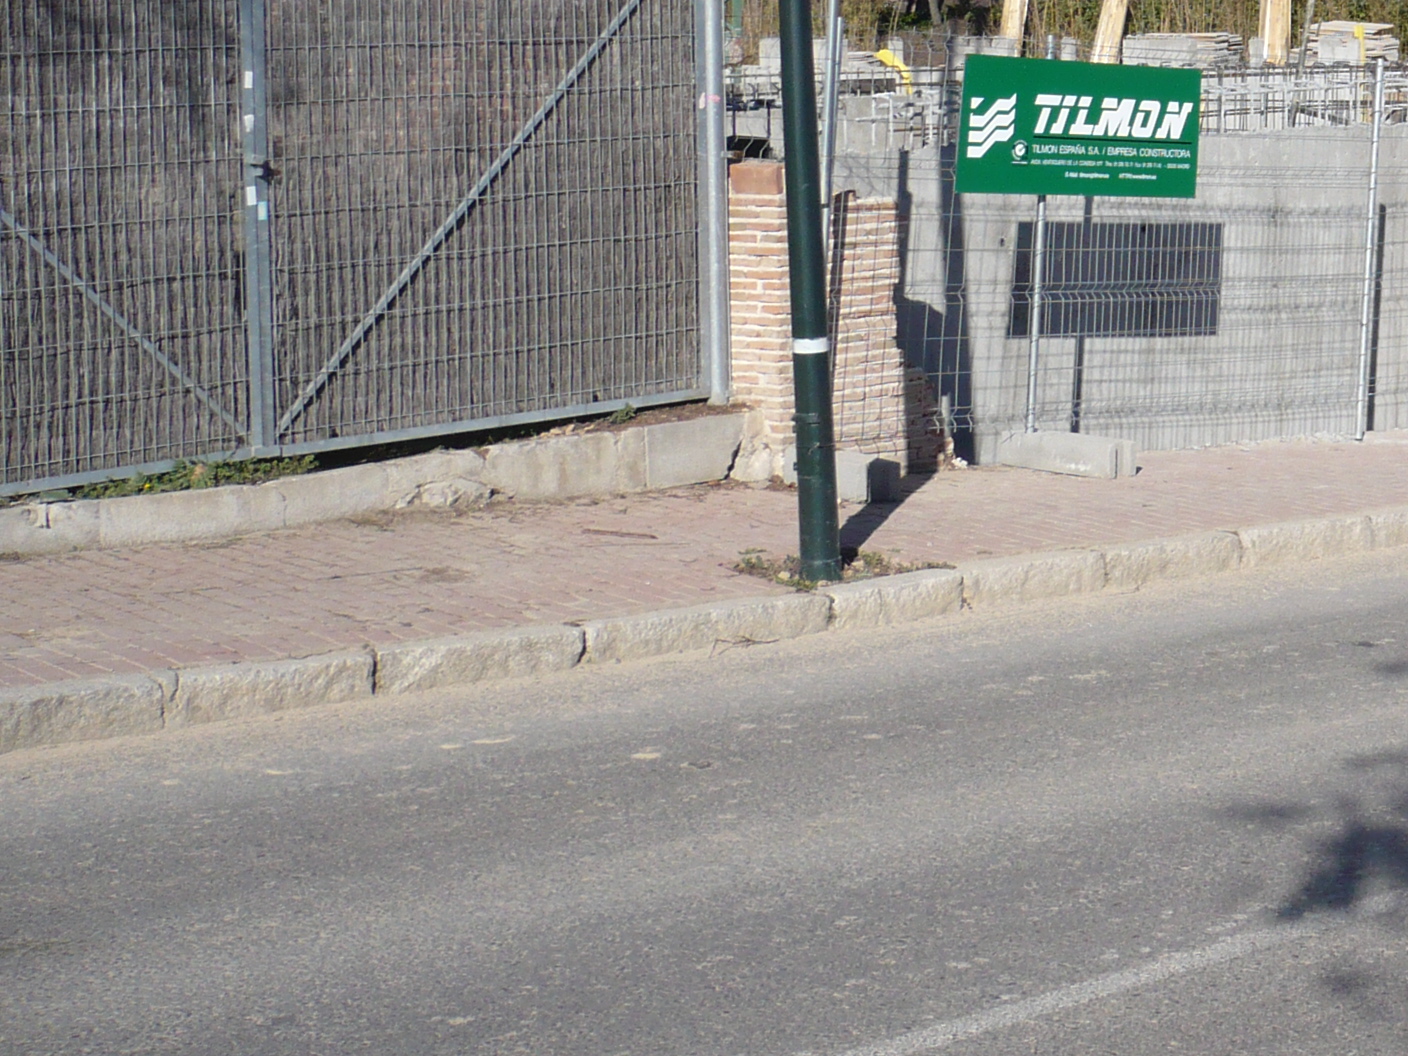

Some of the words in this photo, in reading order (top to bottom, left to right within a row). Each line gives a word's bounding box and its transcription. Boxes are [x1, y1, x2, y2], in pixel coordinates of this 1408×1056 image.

[1033, 93, 1194, 139] TILMON
[1032, 144, 1058, 154] TILMON
[1059, 144, 1086, 155] ESPAÑA
[1107, 146, 1137, 157] EMPRESA
[1139, 148, 1191, 158] CONSTRUCTORA
